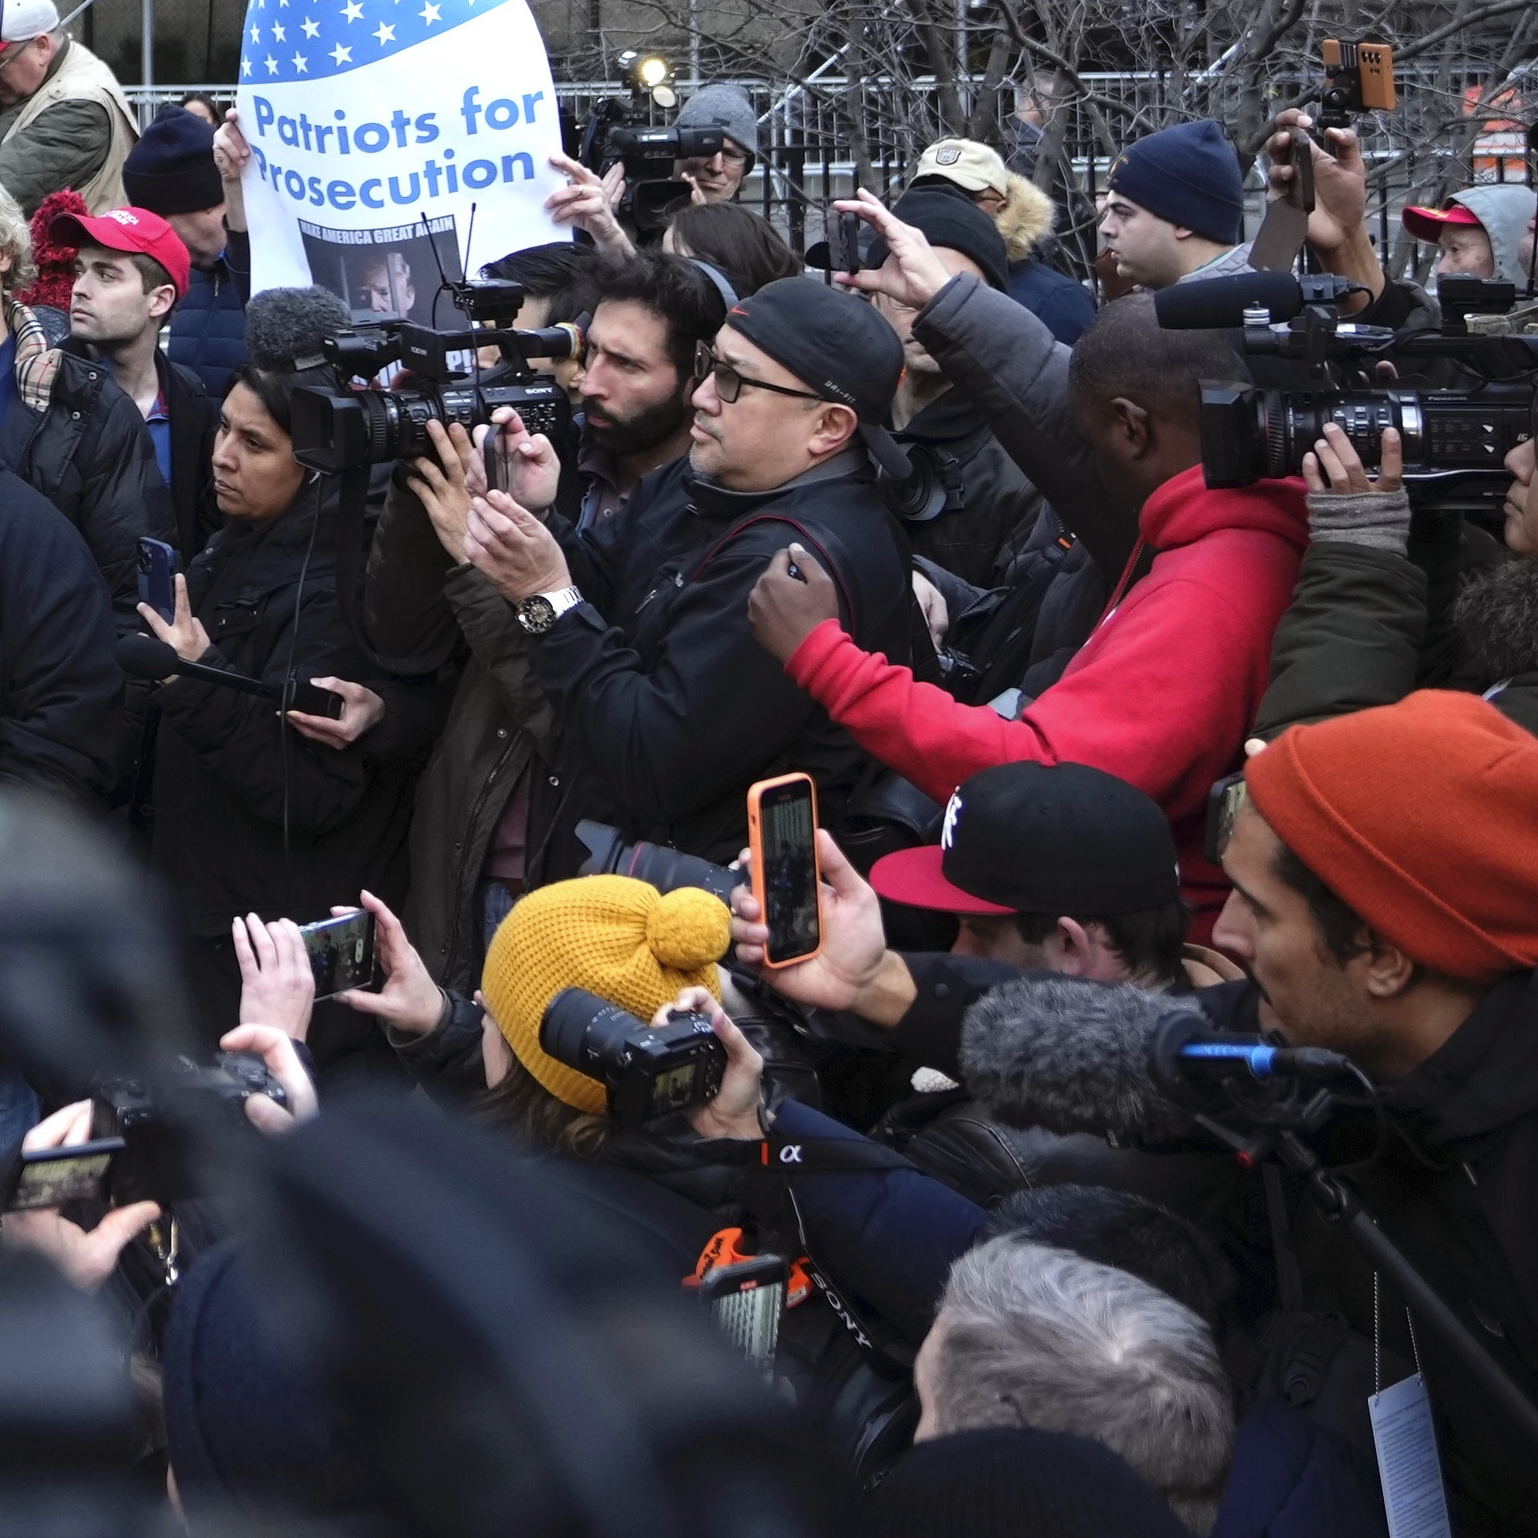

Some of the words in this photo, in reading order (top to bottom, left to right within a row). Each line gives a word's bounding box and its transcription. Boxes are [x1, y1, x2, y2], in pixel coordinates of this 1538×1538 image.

[253, 94, 440, 155] Patriots
[460, 85, 544, 135] for
[249, 144, 536, 211] Prosecution
[322, 227, 374, 245] AMERICA
[374, 223, 415, 244] GREAT
[415, 215, 454, 238] AGAIN
[525, 387, 554, 395] SONY
[811, 1273, 872, 1349] SONY
